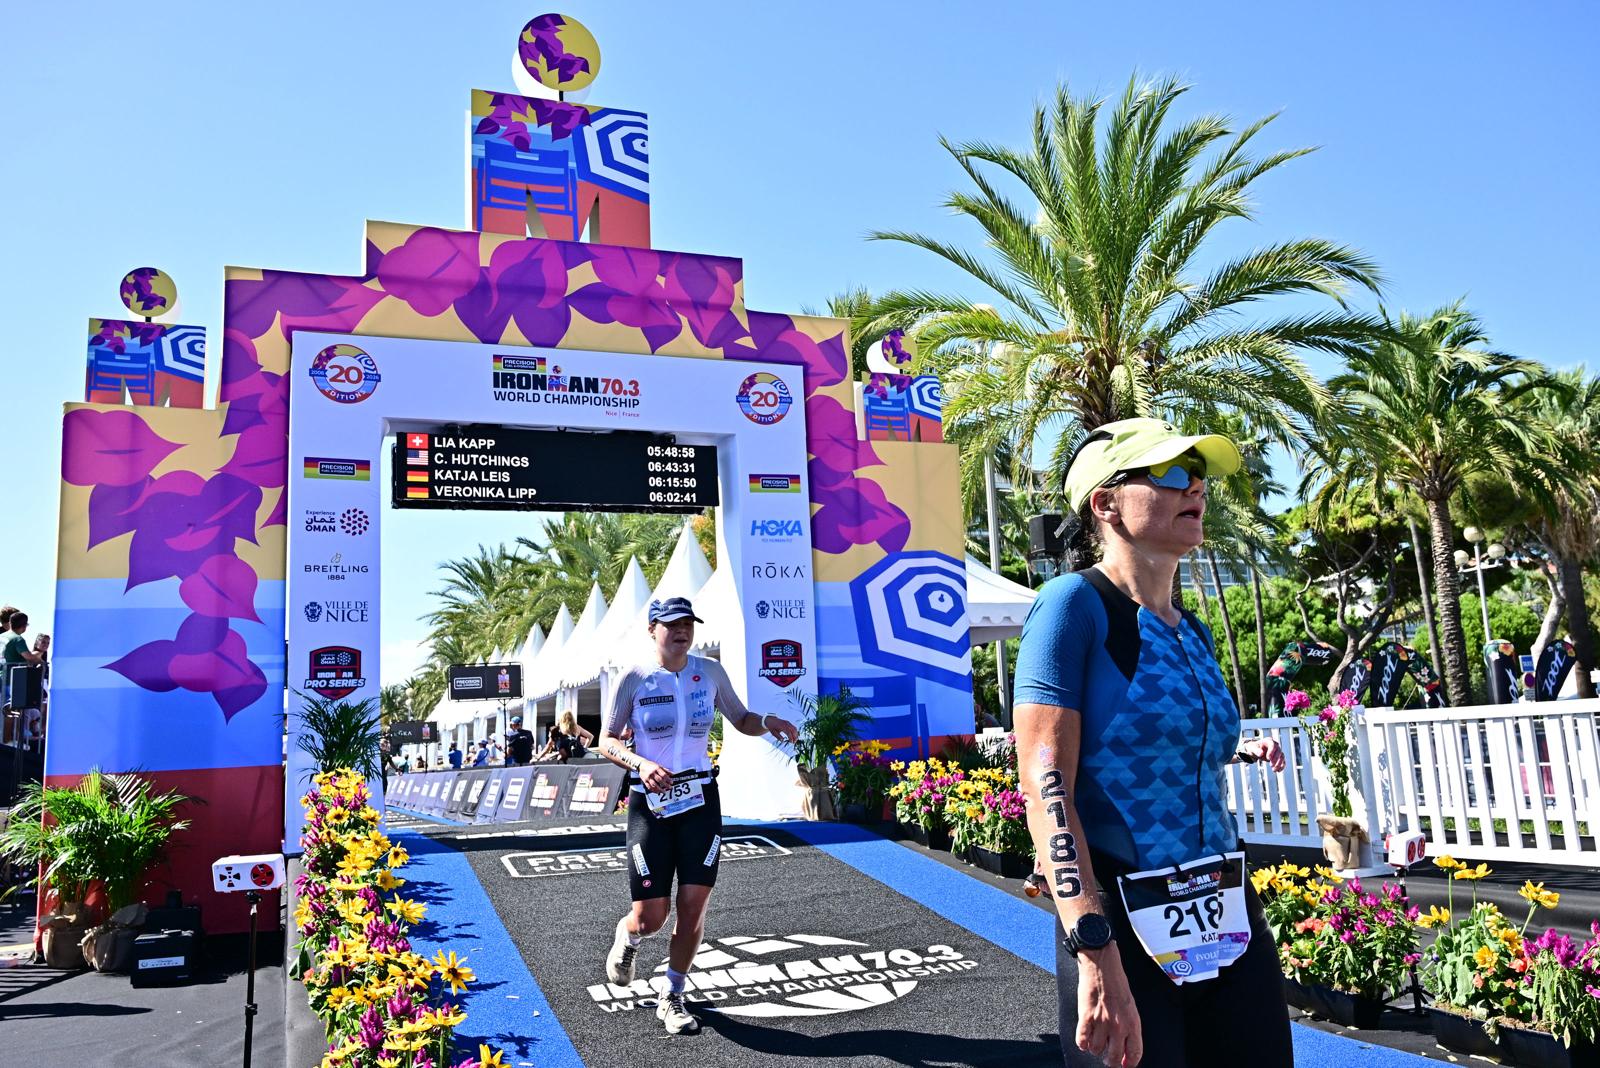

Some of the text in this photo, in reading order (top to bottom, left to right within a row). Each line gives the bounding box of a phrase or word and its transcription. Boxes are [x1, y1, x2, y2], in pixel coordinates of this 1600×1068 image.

[328, 364, 364, 385] 20
[492, 372, 641, 398] IRONMAN 70.3
[494, 390, 641, 409] WORLD CHAMPIONSHIP
[751, 390, 779, 407] 20
[434, 436, 496, 450] LIA KAPP
[647, 446, 696, 459] 05:48:58
[434, 452, 530, 468] C. HUTCHINGS
[321, 463, 354, 471] PRECISION
[647, 461, 695, 473] 06:43:31
[434, 469, 511, 483] KATJA LEIS
[648, 476, 697, 489] 06:15:50
[434, 485, 537, 500] VERONIKA LIPP
[649, 491, 697, 504] 06:02:41
[305, 524, 336, 533] OMAN
[750, 519, 803, 537] HOKA
[304, 564, 369, 573] BREITLING
[325, 600, 369, 609] VILLE DE
[771, 599, 805, 607] VILLE DE
[325, 609, 369, 623] NICE
[772, 606, 806, 619] NICE
[759, 668, 806, 676] PRO SERIES
[304, 678, 365, 688] PRO SERIES
[1040, 770, 1082, 899] 2185
[533, 863, 602, 873] FUEL
[1169, 888, 1190, 897] WORLD
[598, 960, 979, 1013] WOLD CHAMPIONSHIP
